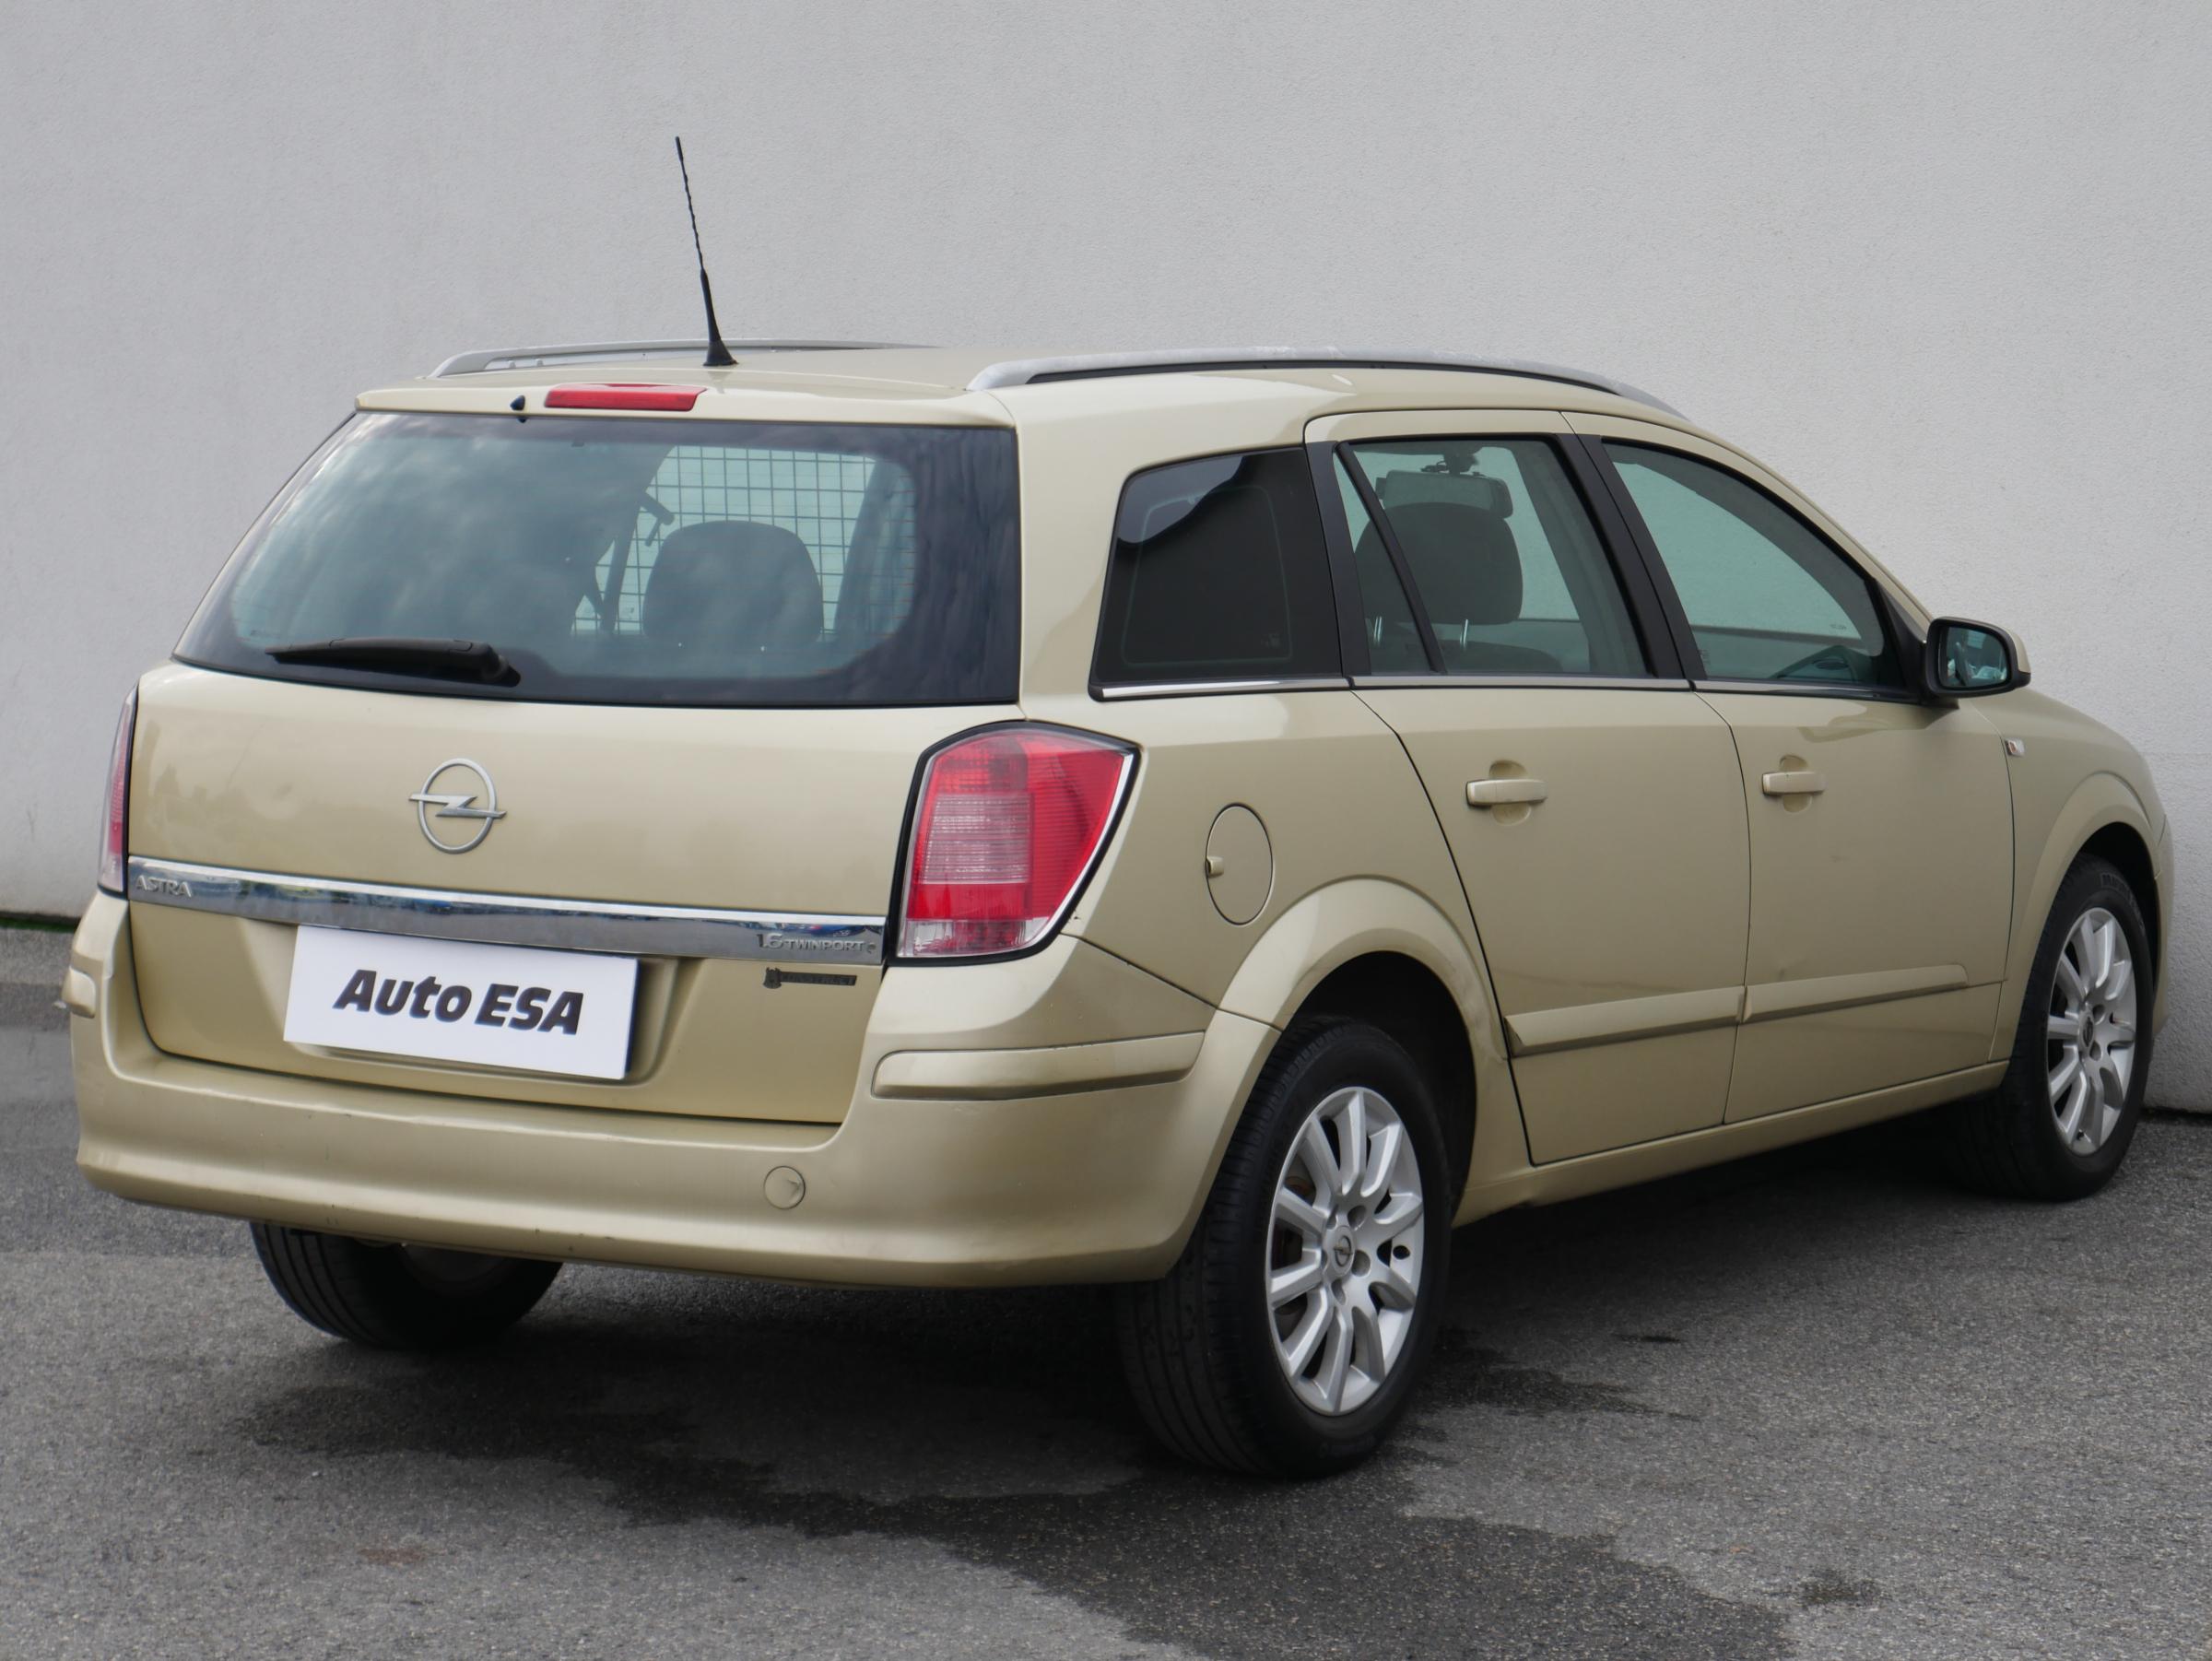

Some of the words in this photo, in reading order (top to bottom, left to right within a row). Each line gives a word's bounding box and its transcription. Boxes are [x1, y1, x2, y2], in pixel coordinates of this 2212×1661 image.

[136, 875, 192, 898] ASTRA
[757, 933, 783, 950] 1.6
[784, 938, 865, 952] TWINPORT
[332, 969, 472, 1023] Auto
[475, 983, 584, 1035] ESA
